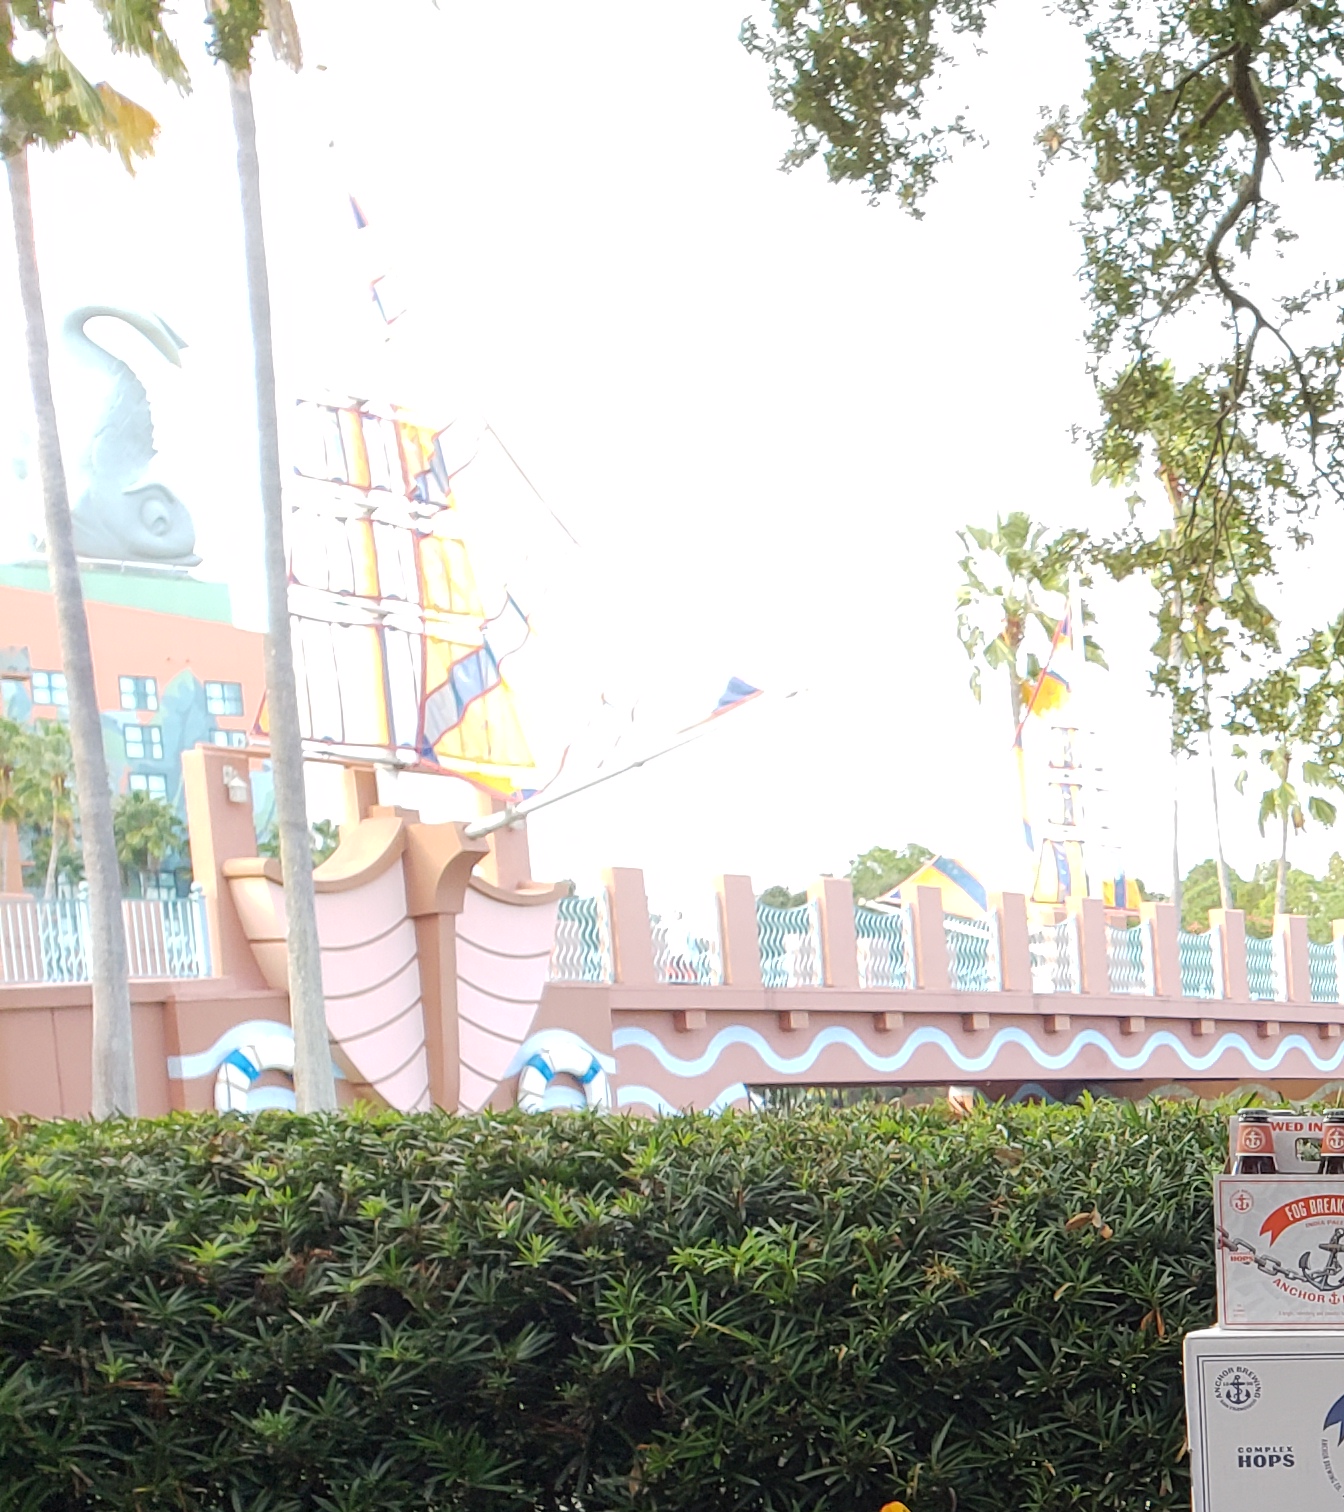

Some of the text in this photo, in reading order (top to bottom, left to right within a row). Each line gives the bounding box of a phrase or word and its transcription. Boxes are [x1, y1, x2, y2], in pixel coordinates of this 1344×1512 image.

[1284, 1202, 1307, 1221] FOG
[1272, 1277, 1326, 1304] ANCHOR
[1215, 1366, 1261, 1398] ANCHOR BREWING
[1238, 1454, 1295, 1468] HOPS
